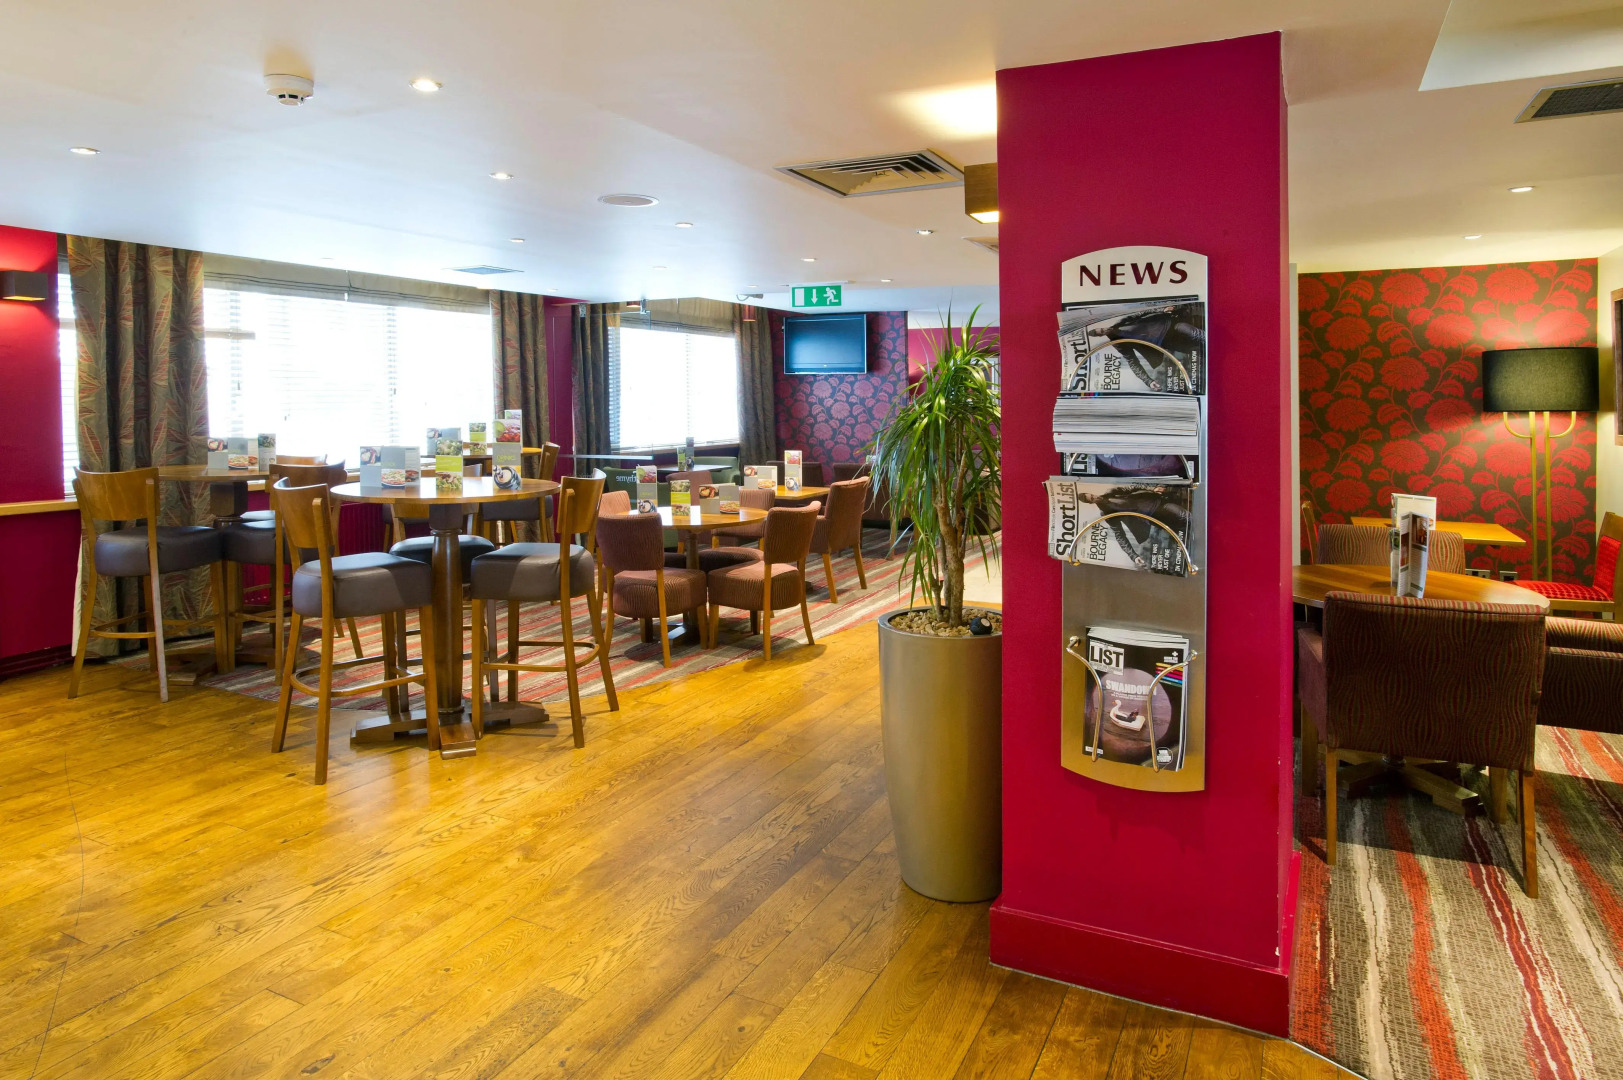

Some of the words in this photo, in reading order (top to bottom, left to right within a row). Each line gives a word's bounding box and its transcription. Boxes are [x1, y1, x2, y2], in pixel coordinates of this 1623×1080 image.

[1079, 260, 1188, 287] NEWS
[1067, 328, 1088, 391] ShortLis
[1103, 353, 1113, 391] BOURNE
[1112, 355, 1121, 391] LEGACY
[1070, 453, 1088, 473] LIS
[1056, 482, 1076, 556] ShortList
[1089, 523, 1101, 560] BOURNE
[1097, 524, 1109, 562] LEGACY
[1175, 544, 1183, 565] CINEM
[1090, 645, 1124, 668] LIST
